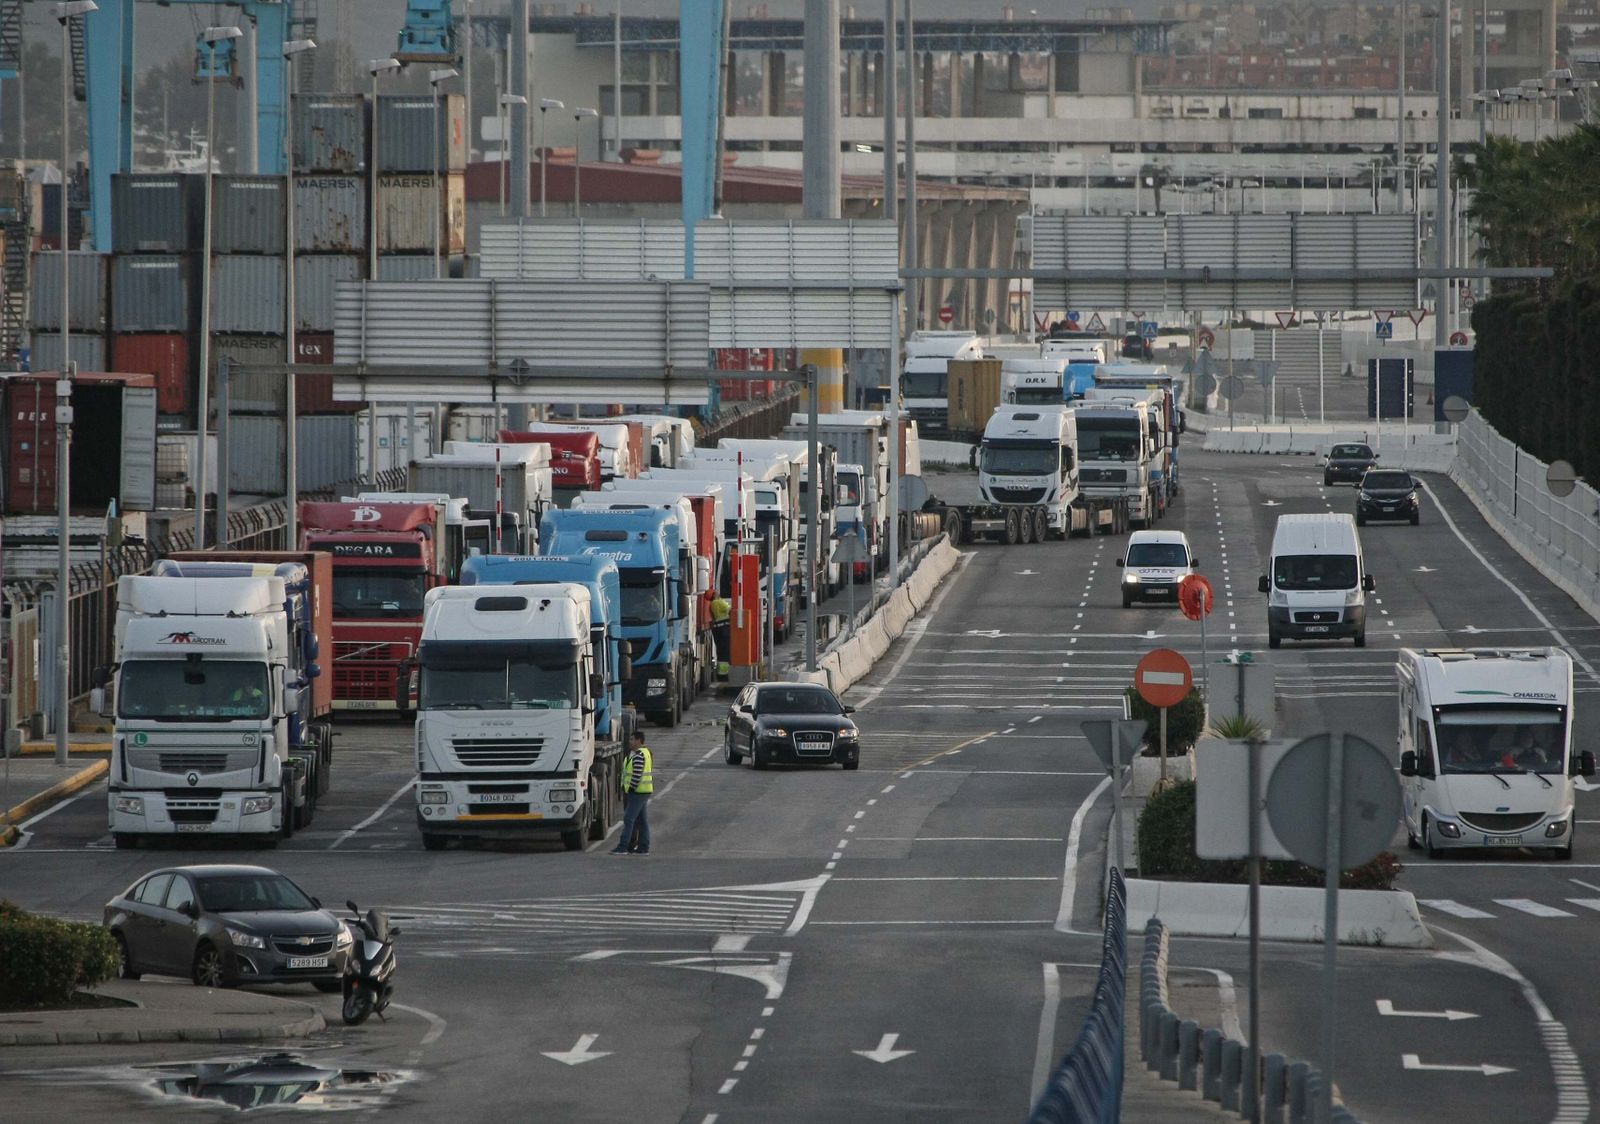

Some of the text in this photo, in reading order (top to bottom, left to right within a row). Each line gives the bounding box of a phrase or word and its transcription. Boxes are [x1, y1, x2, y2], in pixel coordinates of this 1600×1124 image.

[296, 178, 357, 189] MAERSK
[218, 339, 279, 350] MAERSK
[299, 343, 322, 355] tex
[291, 959, 311, 968] 5289
